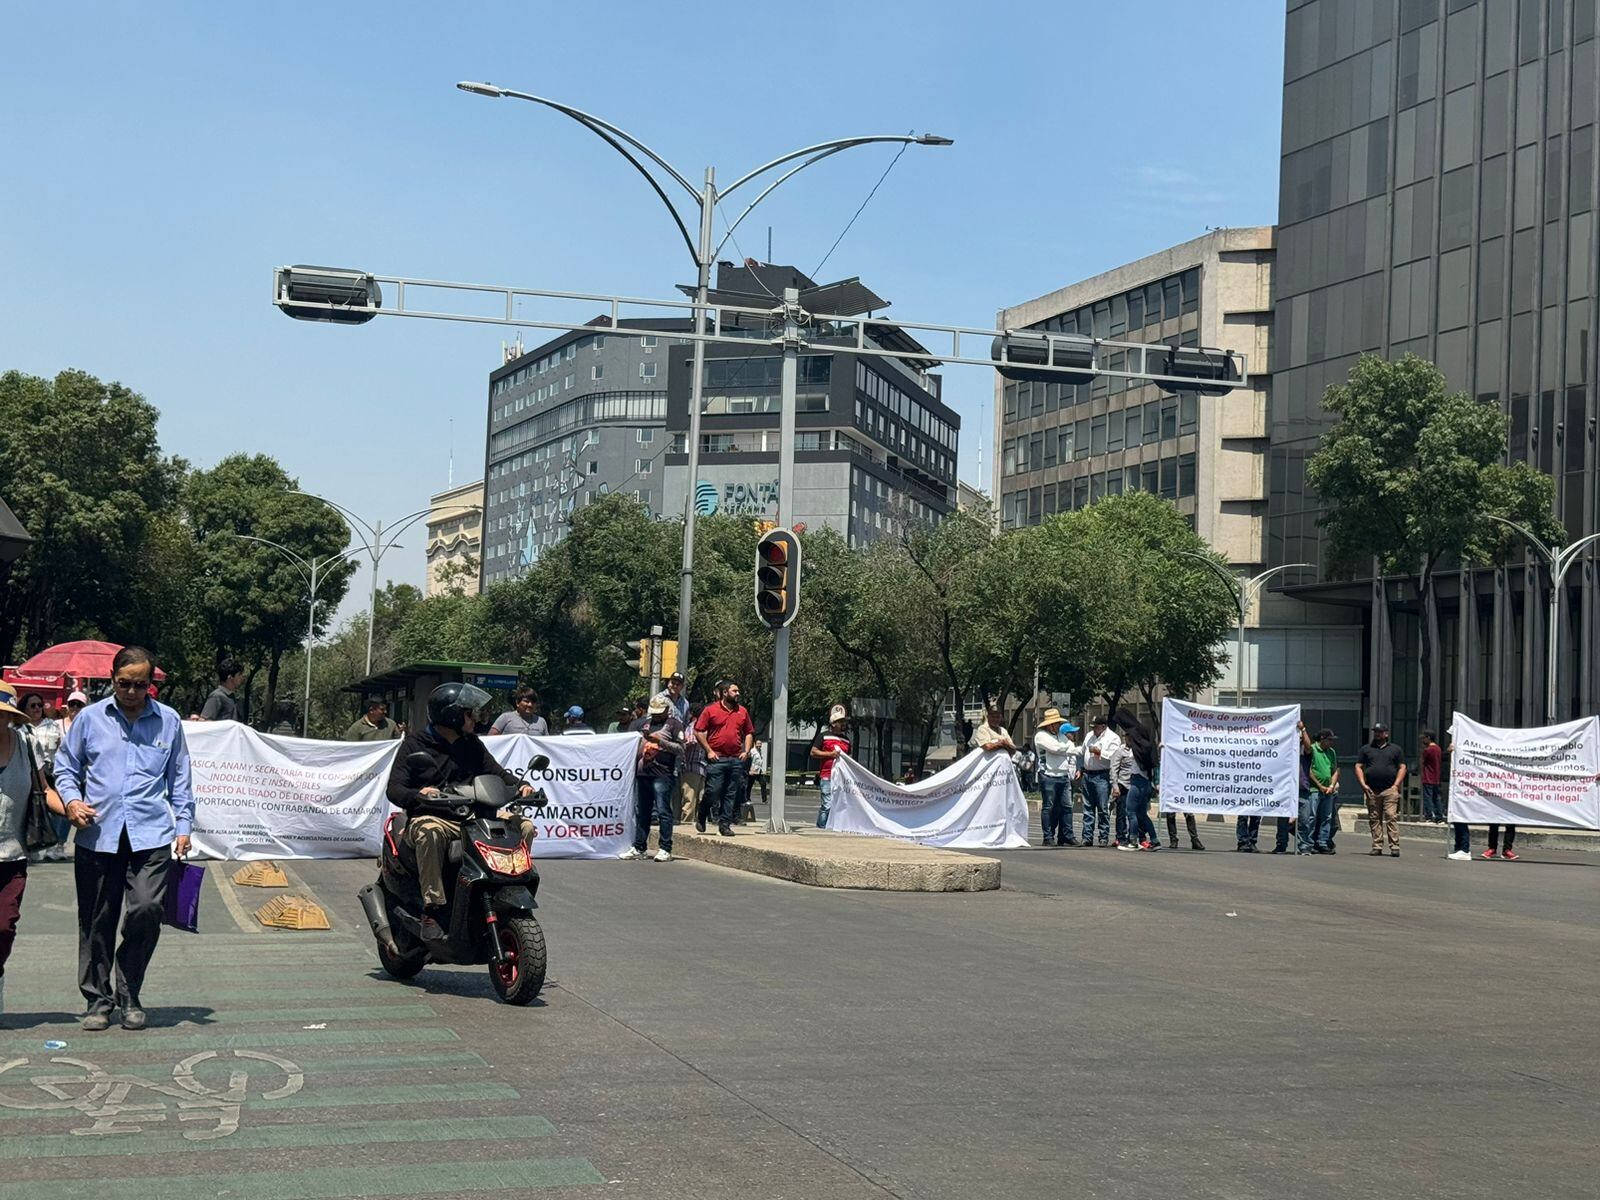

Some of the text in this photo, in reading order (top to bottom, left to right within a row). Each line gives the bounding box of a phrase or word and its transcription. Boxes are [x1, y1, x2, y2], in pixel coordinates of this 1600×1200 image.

[724, 479, 780, 504] FONTÁ
[1187, 709, 1274, 723] Miles de empleos
[1191, 722, 1269, 734] se han perdido.
[1182, 733, 1279, 746] Los mexicanos nos
[1183, 747, 1278, 760] estamos quedando
[1550, 741, 1583, 754] pueblo
[1200, 759, 1262, 770] sin sustento
[1458, 757, 1471, 766] de
[1550, 753, 1577, 763] culpa
[190, 759, 219, 770] ASICA,
[219, 761, 247, 771] ANAM
[530, 764, 623, 782] CONSULTÓ
[1186, 770, 1273, 784] mientras grandes
[1452, 769, 1476, 780] Exige
[1486, 770, 1515, 780] ANAM
[1525, 772, 1577, 782] SENASICA
[210, 773, 259, 785] INDOLENTES
[268, 778, 321, 790] INSENSIBLES
[1458, 780, 1588, 794] detengan las importaciones
[196, 784, 234, 794] RESPETO
[235, 787, 246, 795] AL
[279, 791, 291, 800] DE
[293, 792, 333, 803] DERECHO
[1183, 783, 1275, 795] comercializadores
[1174, 795, 1284, 808] se llenan los bolsillos.
[1464, 788, 1476, 797] de
[1520, 792, 1544, 803] legal
[1545, 794, 1552, 802] e
[1554, 793, 1583, 805] ilegal.
[261, 802, 328, 815] CONTRABANDO
[329, 807, 341, 815] DE
[342, 806, 383, 815] CAMARÓN
[521, 803, 619, 819] CAMARÓN!:
[543, 823, 625, 838] YOREMES
